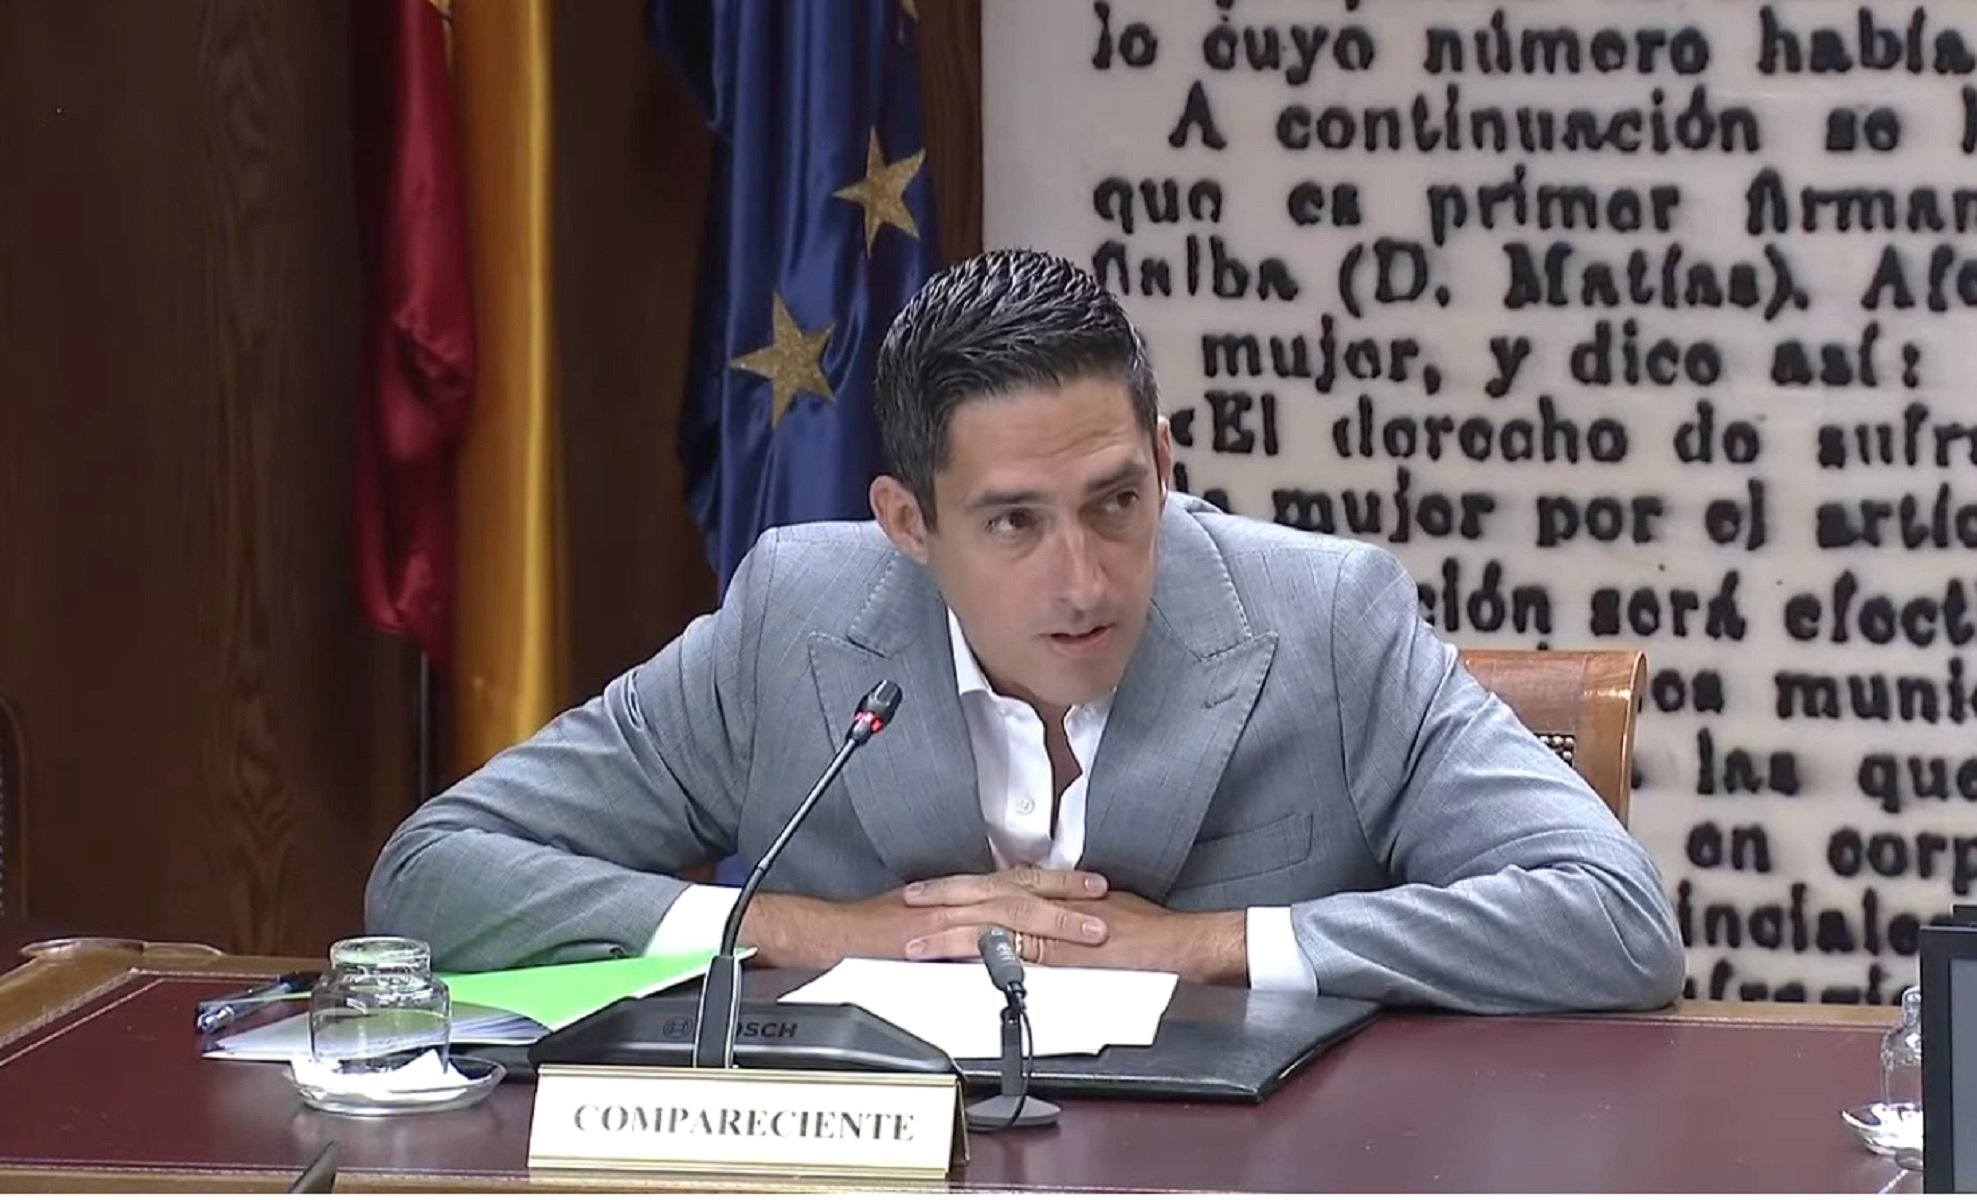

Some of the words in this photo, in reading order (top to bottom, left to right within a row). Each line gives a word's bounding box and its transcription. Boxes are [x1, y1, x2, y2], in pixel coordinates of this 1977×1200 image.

[1091, 2, 1158, 71] lo
[1168, 80, 1227, 151] A
[1485, 336, 1532, 399] y
[1536, 496, 1665, 548] por
[1774, 657, 1977, 724] muni
[735, 1022, 797, 1038] SCH
[573, 1103, 915, 1142] COMPARECIENTE
